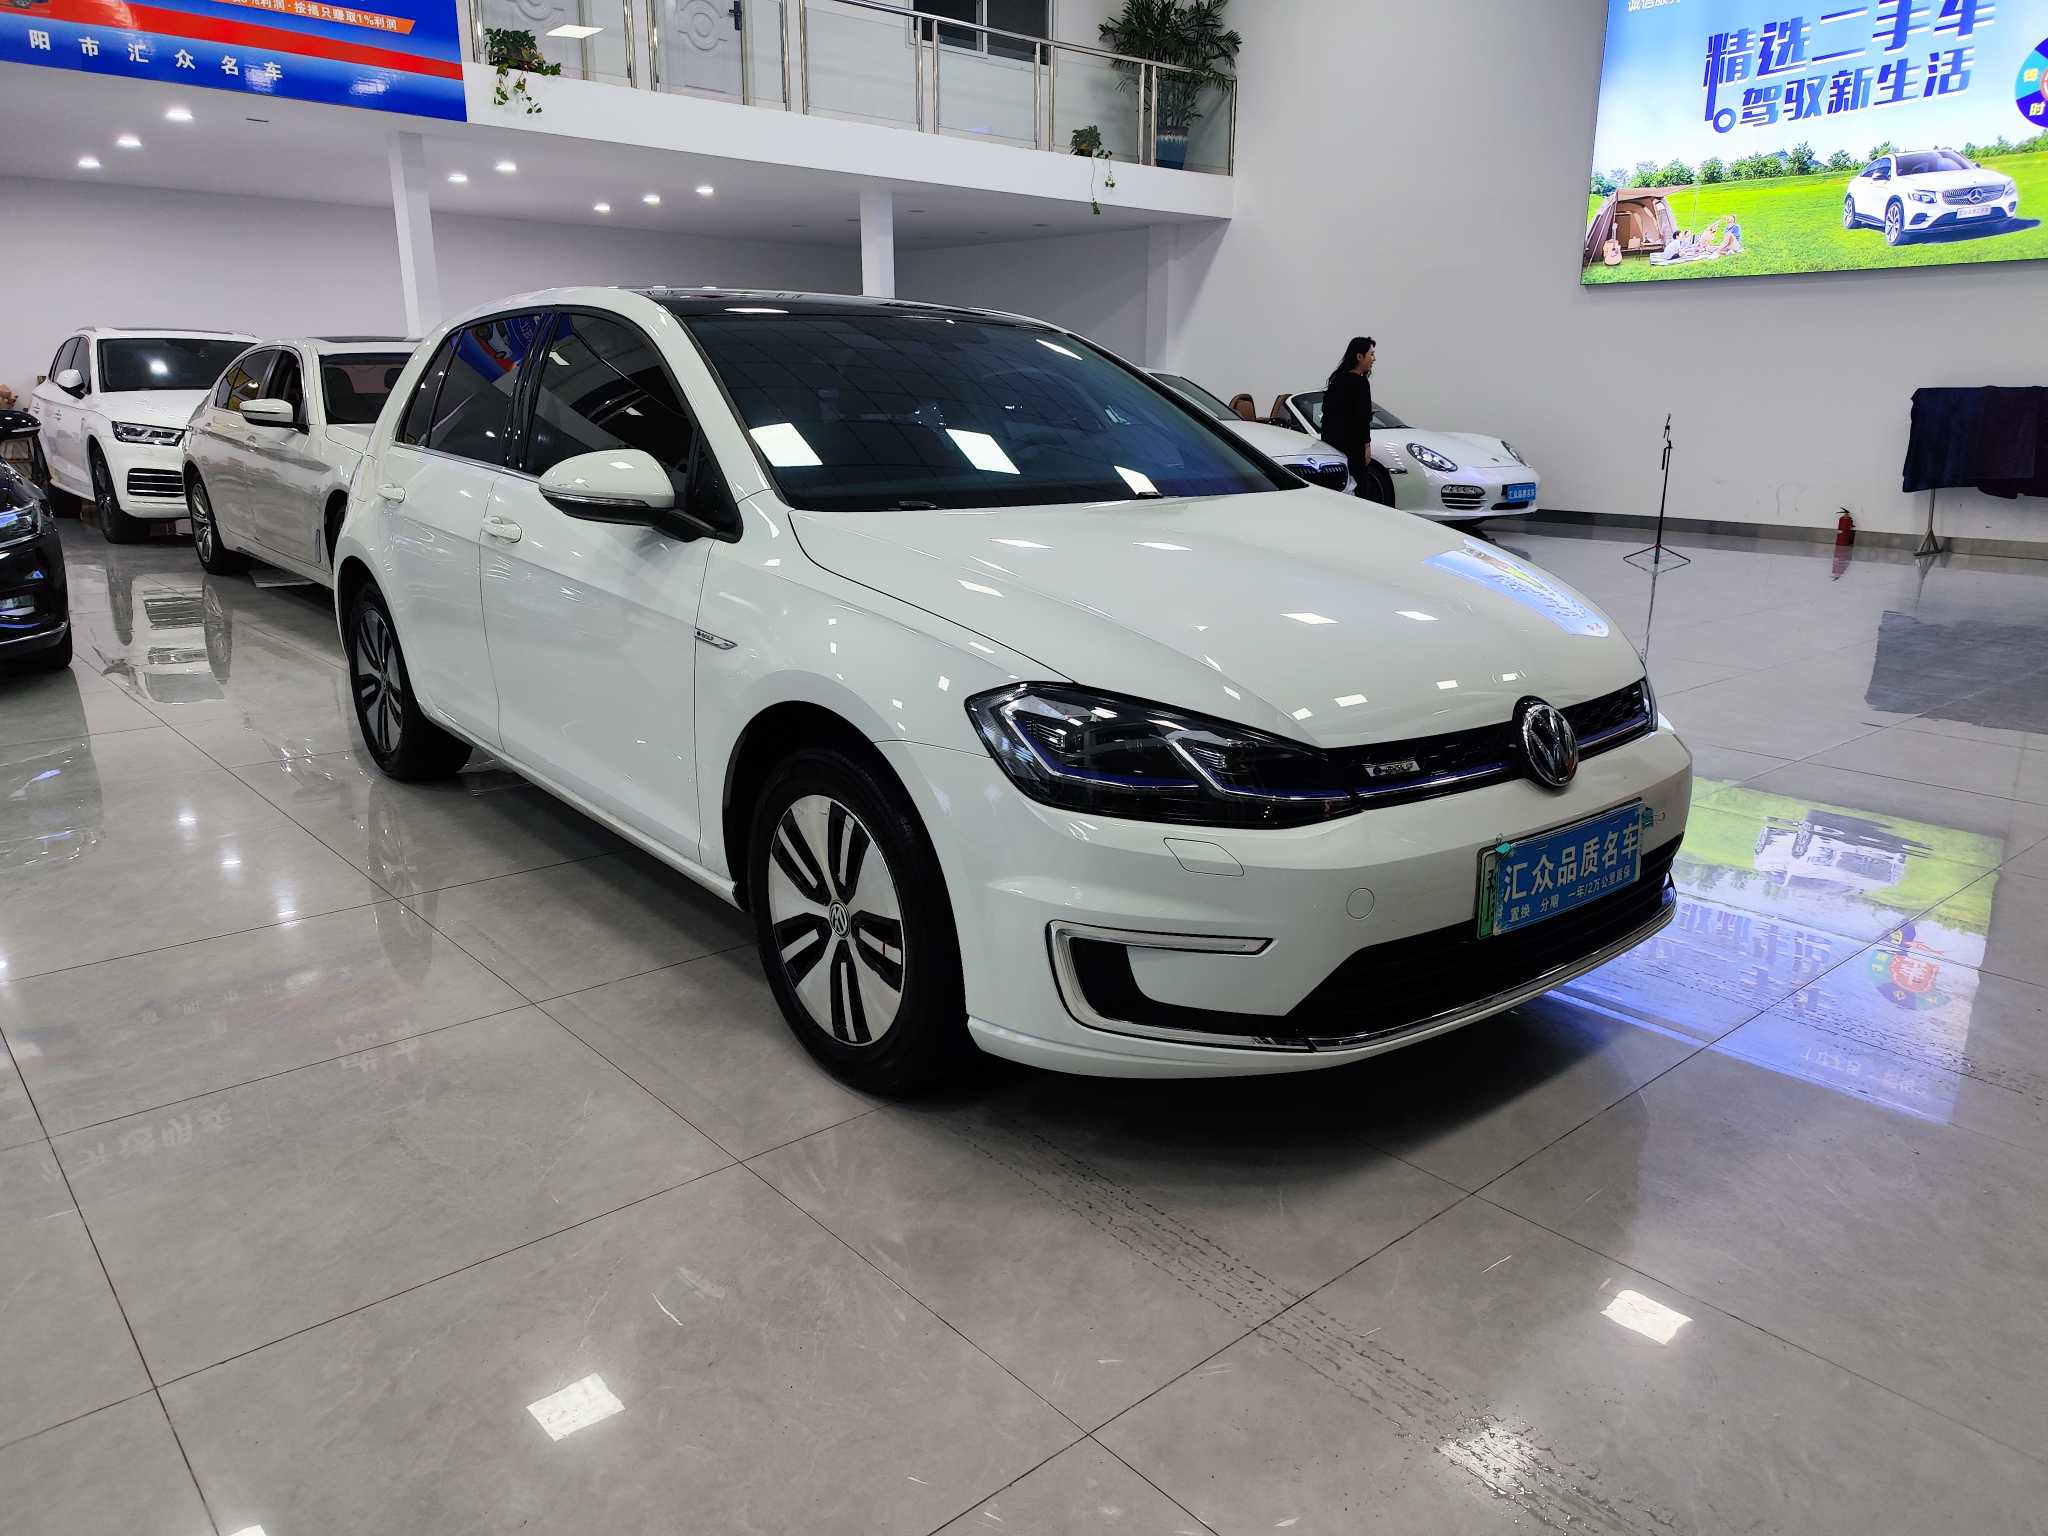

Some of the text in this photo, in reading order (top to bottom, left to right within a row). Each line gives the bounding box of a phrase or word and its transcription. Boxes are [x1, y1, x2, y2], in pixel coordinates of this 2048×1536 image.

[1703, 0, 1996, 98] 精选二手车
[1740, 47, 1975, 127] 驾驭新生活
[1503, 823, 1640, 904] 汇众品质名车
